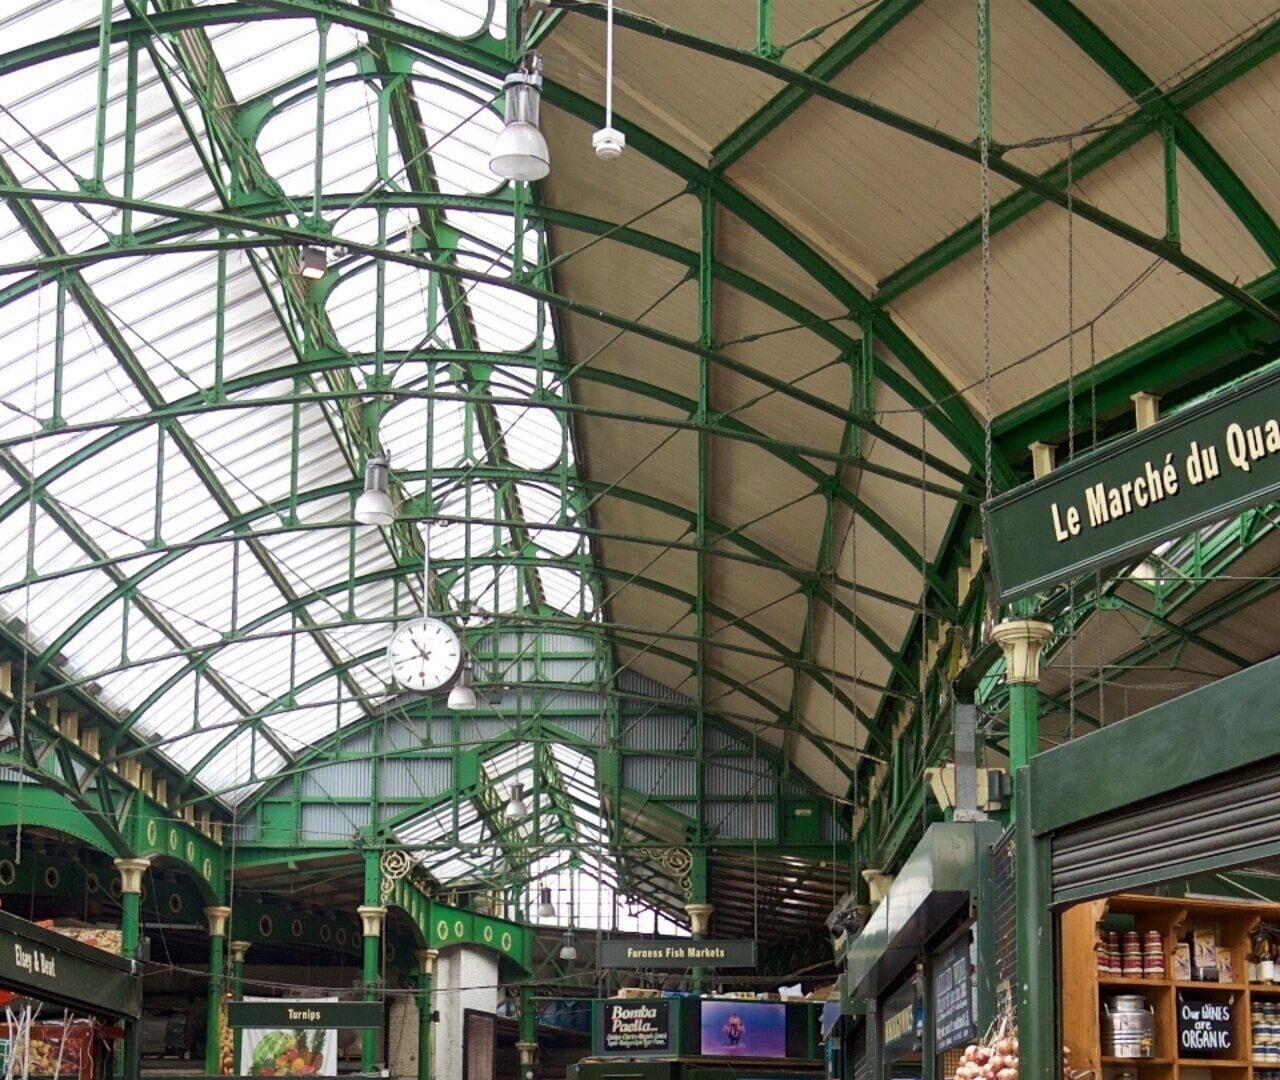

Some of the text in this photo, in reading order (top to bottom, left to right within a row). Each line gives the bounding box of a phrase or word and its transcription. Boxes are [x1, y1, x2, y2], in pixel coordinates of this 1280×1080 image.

[1051, 503, 1081, 542] Le
[1085, 453, 1178, 528] Marché
[1186, 441, 1220, 486] du
[628, 948, 725, 958] Furness Fish Markets
[33, 950, 40, 972] &
[287, 1008, 320, 1021] Turnips
[612, 1005, 657, 1019] Bomba
[1194, 1020, 1212, 1031] are
[1181, 1031, 1231, 1049] ORGANIC
